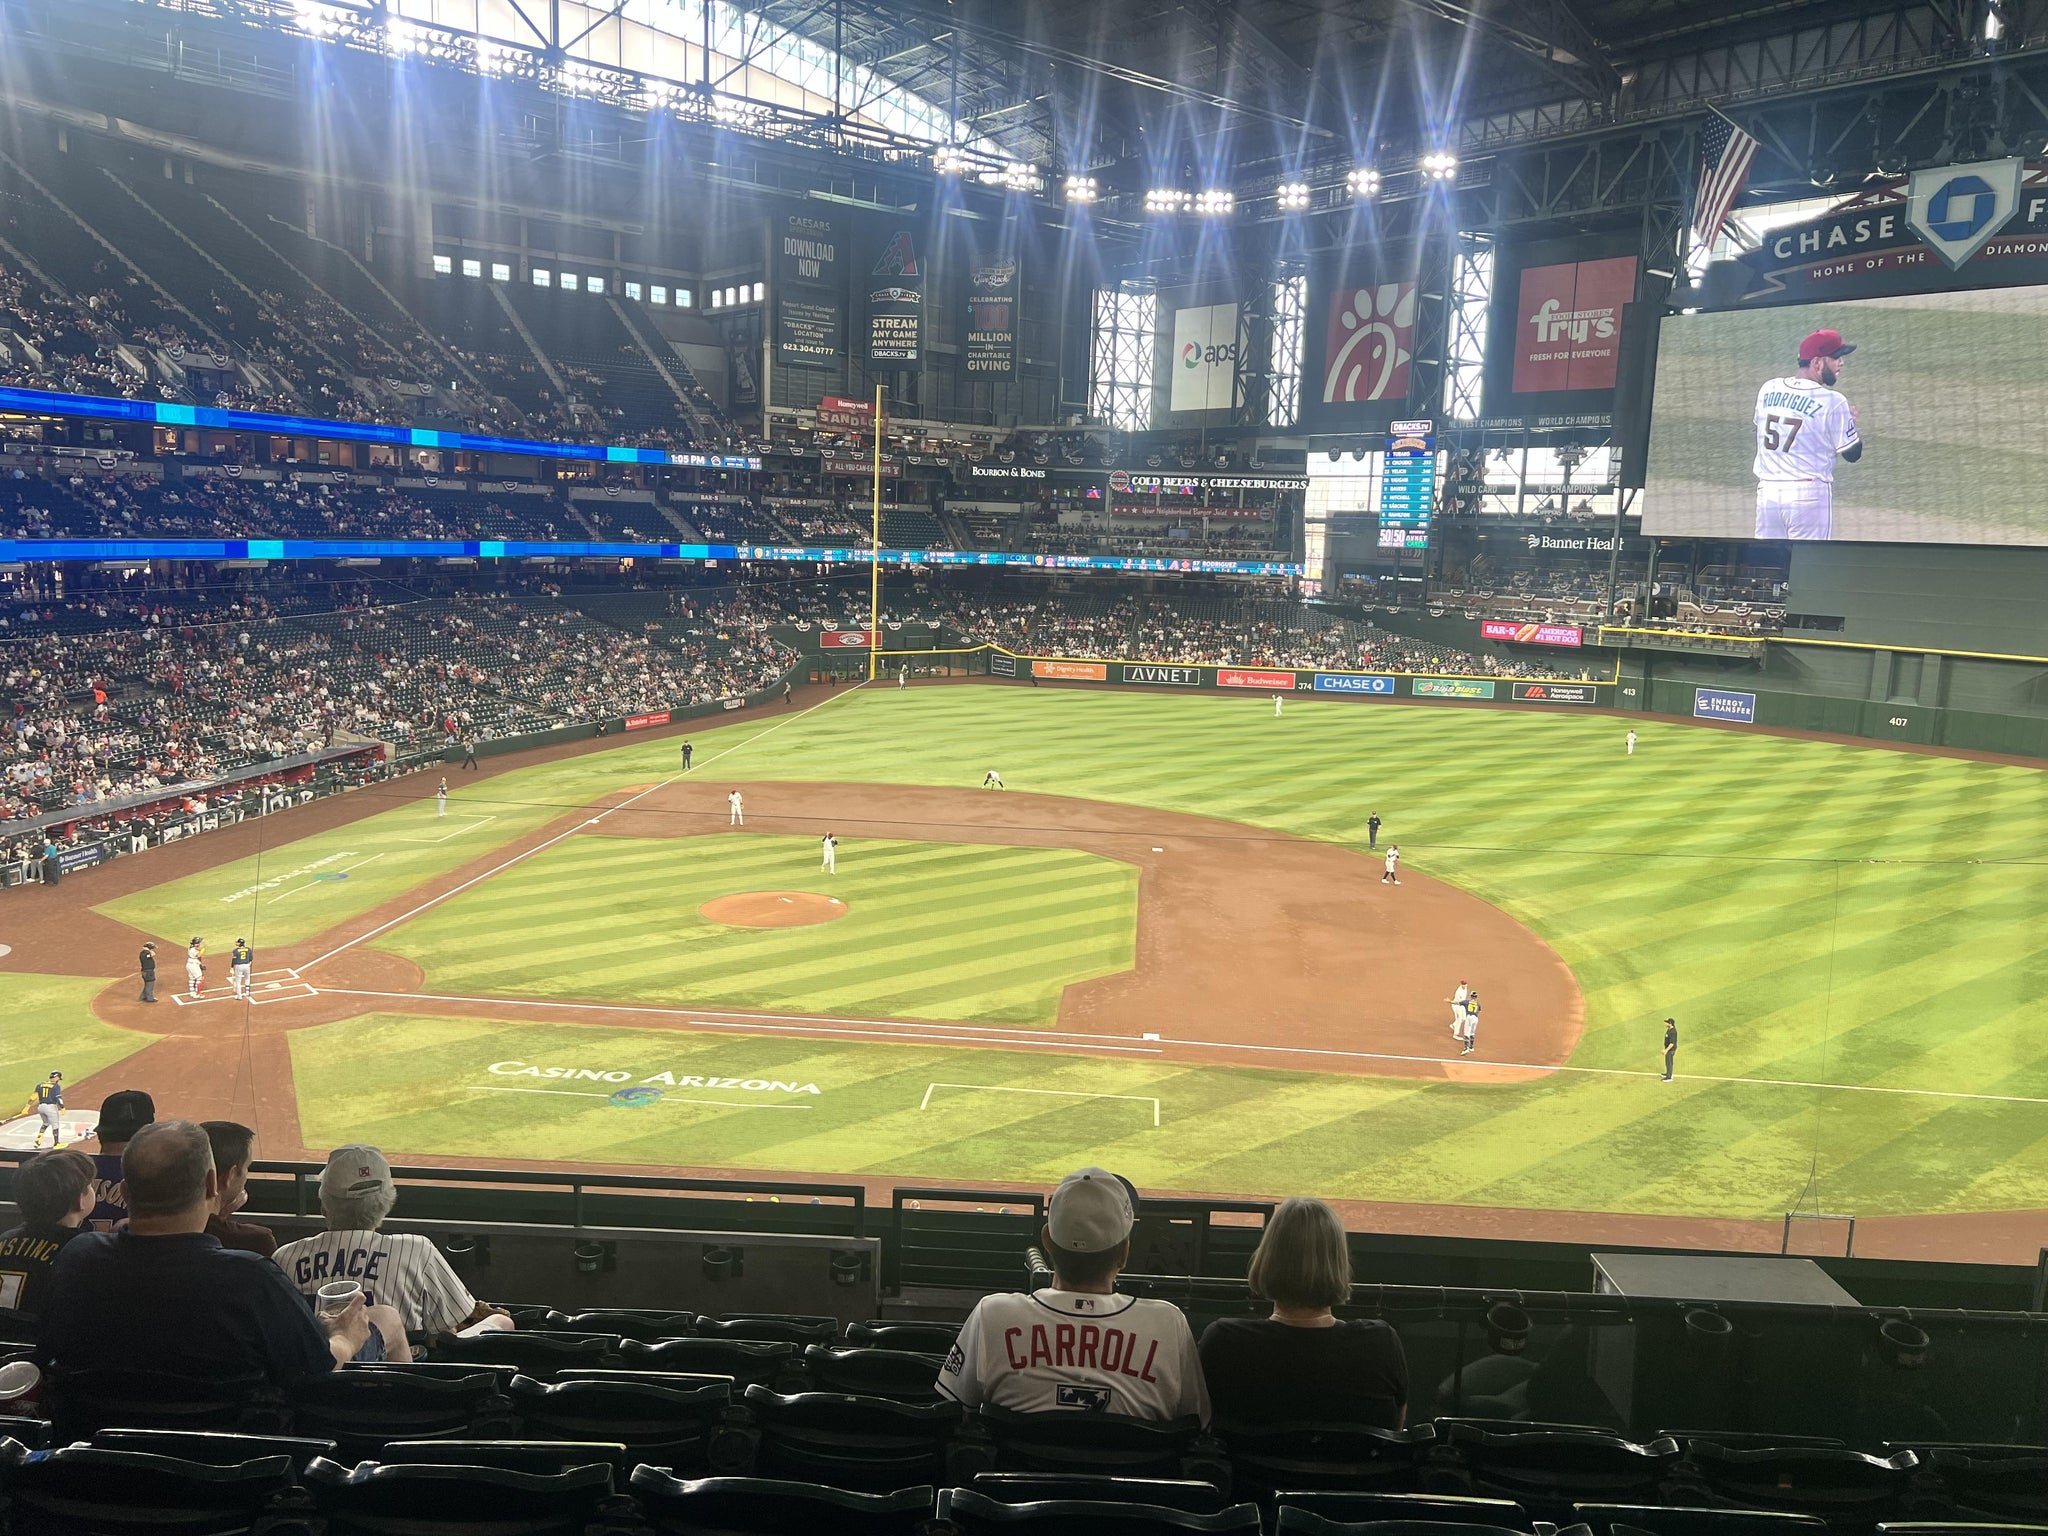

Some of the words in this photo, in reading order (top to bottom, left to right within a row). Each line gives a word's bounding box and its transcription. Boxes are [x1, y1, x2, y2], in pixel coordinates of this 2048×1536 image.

[789, 216, 831, 231] CAESARS
[1774, 216, 1894, 259] CHASE
[784, 237, 834, 261] DOWNLOAD
[799, 258, 820, 278] NOW
[1814, 263, 1853, 278] HOME
[1867, 258, 1884, 268] OF
[1897, 253, 1925, 264] THE
[1578, 309, 1610, 319] STORES
[872, 319, 918, 329] STREAM
[1530, 298, 1615, 344] fry's
[794, 330, 824, 338] LOCATION
[872, 330, 890, 338] ANY
[893, 330, 917, 338] GAME
[968, 333, 1012, 342] MILLION
[782, 343, 834, 355] 623.304.0777
[1571, 349, 1611, 358] EVERYONE
[967, 360, 1010, 371] GIVING
[838, 400, 868, 410] Honeywell
[1763, 391, 1823, 418] RODRIGUEZ
[1480, 418, 1522, 427] CHAMPIONS
[1538, 417, 1564, 425] WORLD
[1565, 415, 1611, 425] CHAMPIONS
[1764, 413, 1803, 453] 57
[671, 455, 689, 464] 1:05
[690, 455, 705, 465] PM
[1010, 467, 1019, 477] &
[1131, 476, 1160, 486] COLD
[1163, 477, 1199, 487] BEERS
[1200, 478, 1208, 487] &
[1210, 478, 1308, 489] CHEESEBURGERS
[1458, 485, 1476, 493] WILD
[1478, 484, 1498, 493] CARD
[1538, 485, 1550, 493] NL
[1551, 484, 1598, 493] CHAMPIONS
[1142, 507, 1155, 516] Your
[1156, 507, 1192, 516] Neighborhood
[1193, 508, 1213, 516] Burger
[1541, 536, 1585, 549] Banner
[1486, 625, 1516, 636] BAR-S
[1539, 627, 1578, 637] AMERICA'S
[1545, 634, 1561, 642] HOT
[1562, 635, 1578, 643] DOG
[1056, 665, 1076, 674] Dignity
[1077, 666, 1094, 674] Health
[1131, 667, 1192, 683] AVNET
[1247, 676, 1288, 686] Budweiser
[1298, 682, 1312, 690] 374
[1324, 678, 1370, 689] CHASE
[1550, 687, 1583, 695] Honeywell
[1550, 692, 1584, 700] Aerospace
[1622, 688, 1636, 696] 413
[1711, 697, 1743, 707] ENERGY
[1711, 704, 1751, 715] TRANSFER
[1889, 717, 1908, 727] 407
[488, 1061, 633, 1082] CASINO
[639, 1070, 822, 1095] ARIZONA
[42, 1087, 49, 1098] 11
[296, 1249, 387, 1284] GRACE
[1004, 1323, 1158, 1384] CARROLL
